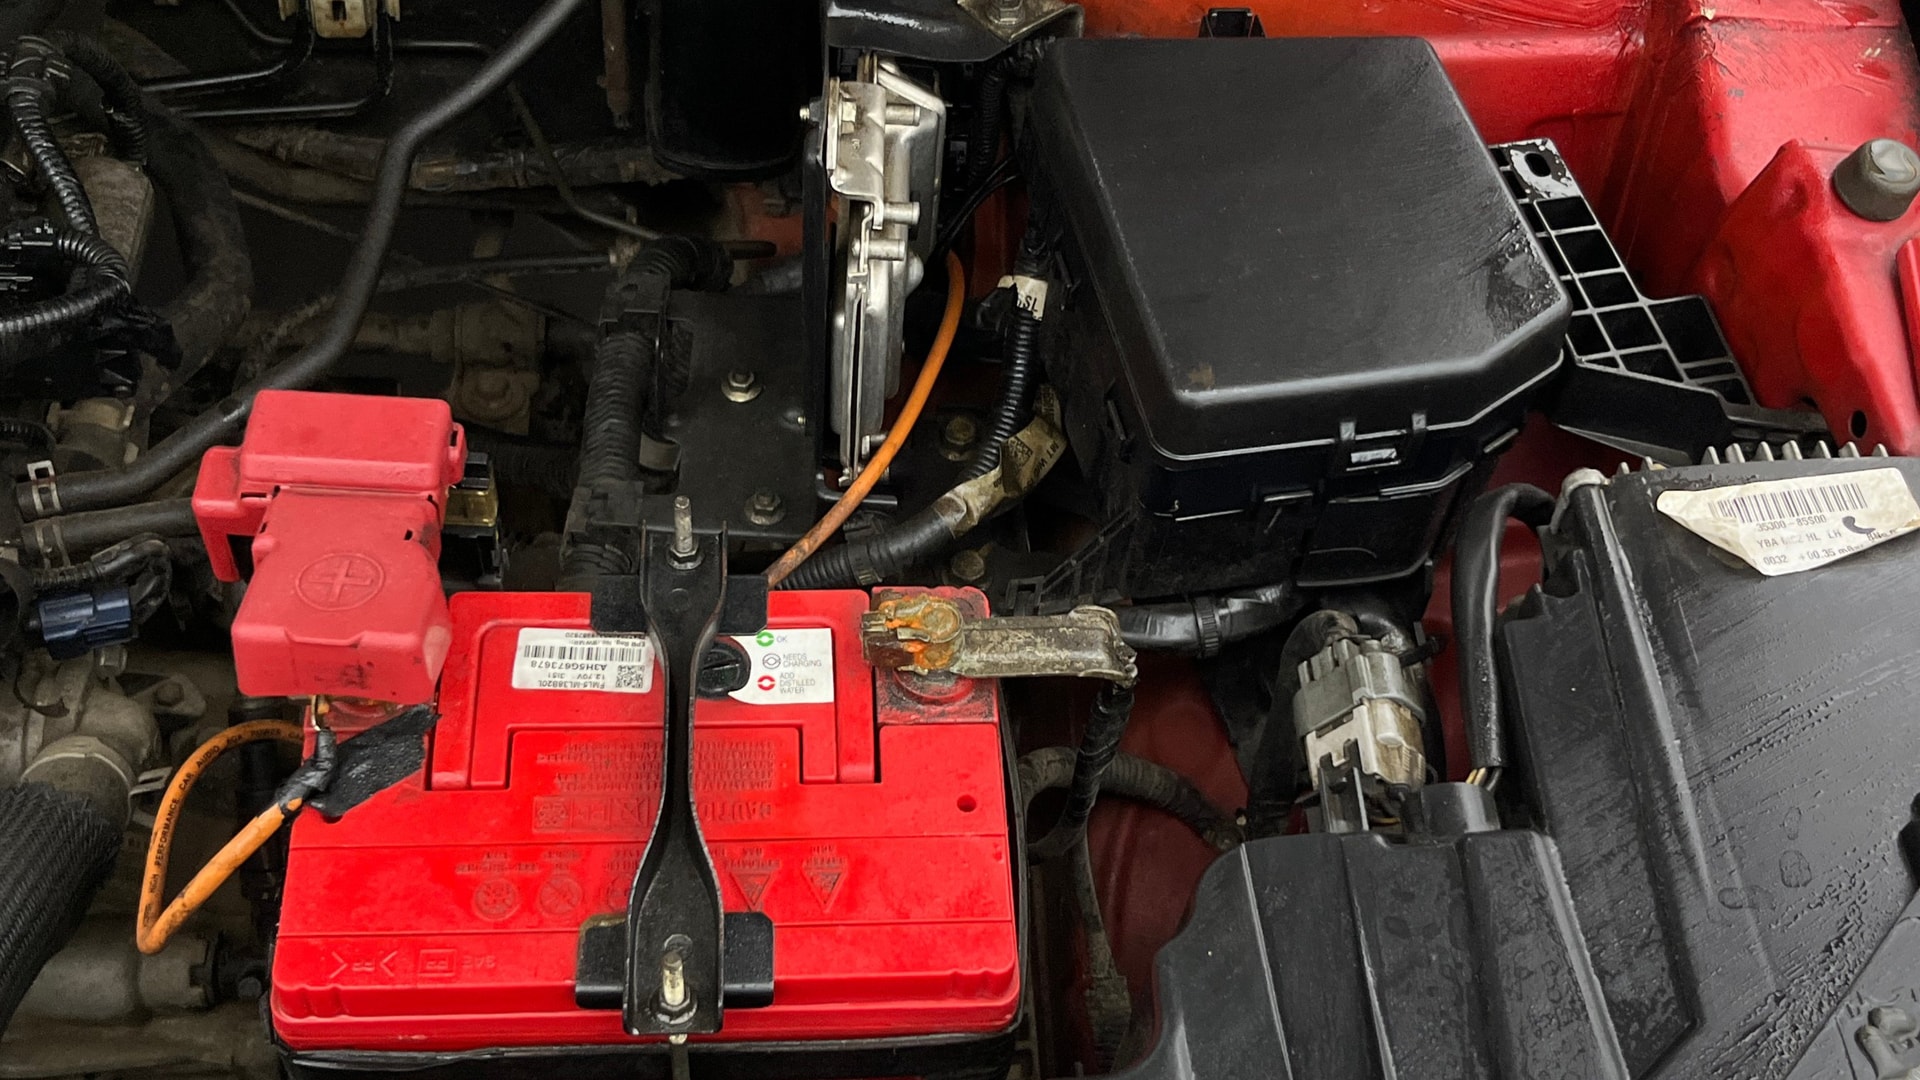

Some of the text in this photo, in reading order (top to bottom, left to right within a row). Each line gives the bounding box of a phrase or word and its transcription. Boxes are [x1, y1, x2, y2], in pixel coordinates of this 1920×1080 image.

[1763, 554, 1788, 566] 0032
[776, 635, 788, 643] OK
[782, 652, 808, 660] NEEDS
[530, 660, 608, 671] A3H5G673678
[782, 659, 822, 668] CHARGING
[779, 678, 816, 687] DISTILLED
[779, 686, 805, 694] WATER
[154, 798, 179, 866] PERFORMANCE
[178, 772, 195, 791] CAR
[196, 745, 220, 769] AUDIO
